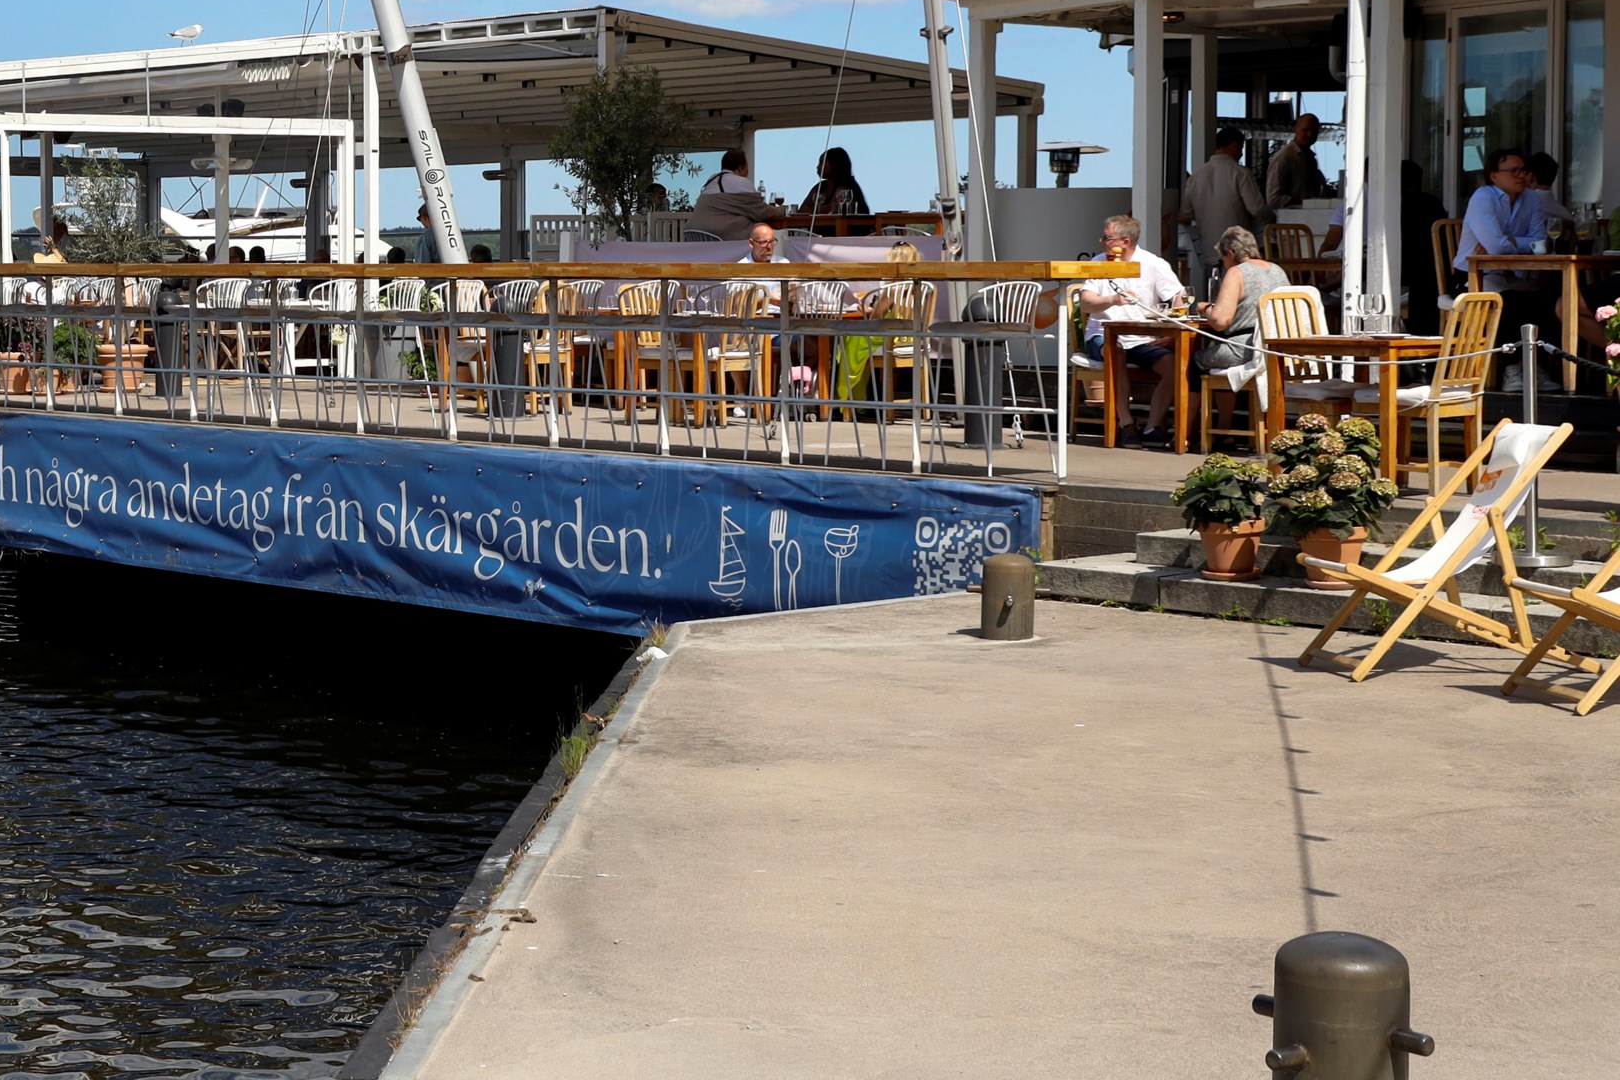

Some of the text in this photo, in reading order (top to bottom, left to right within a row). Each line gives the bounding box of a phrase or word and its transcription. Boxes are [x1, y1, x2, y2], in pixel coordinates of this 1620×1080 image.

[418, 129, 458, 248] SAIL RACING
[25, 457, 118, 529] några
[126, 461, 276, 553] andetag
[282, 473, 367, 544] från
[376, 480, 663, 581] skärgården.
